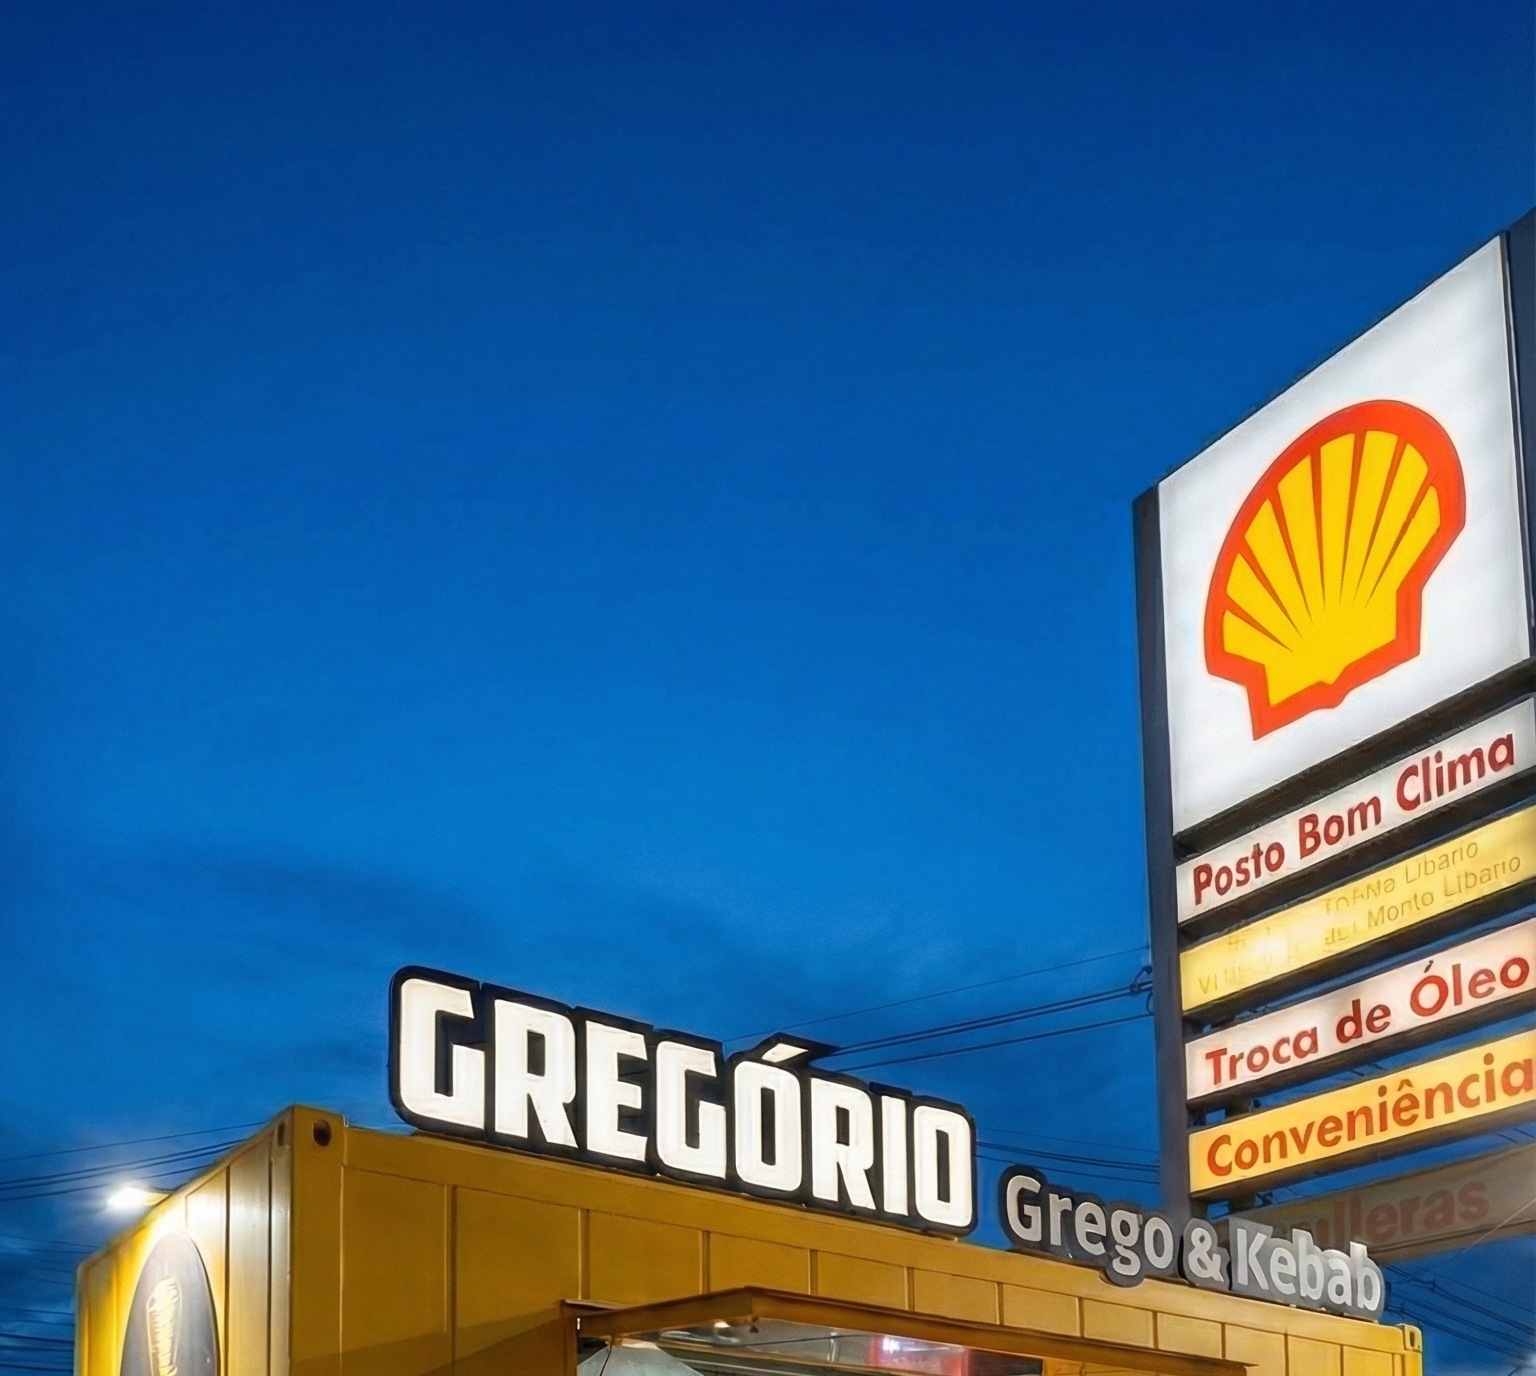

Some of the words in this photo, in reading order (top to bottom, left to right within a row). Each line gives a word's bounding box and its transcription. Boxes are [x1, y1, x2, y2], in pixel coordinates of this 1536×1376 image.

[1193, 842, 1286, 906] Posto
[1298, 793, 1382, 860] Bom
[1396, 733, 1514, 811] Clima
[1205, 1028, 1318, 1086] Troca
[1336, 999, 1391, 1044] de
[1410, 960, 1530, 1017] Óleo
[400, 977, 973, 1227] GREGÓRIO
[1207, 1053, 1534, 1177] Conveniência
[1006, 1174, 1174, 1276] Grego
[1187, 1226, 1224, 1283] &
[1236, 1227, 1381, 1312] Kebab
